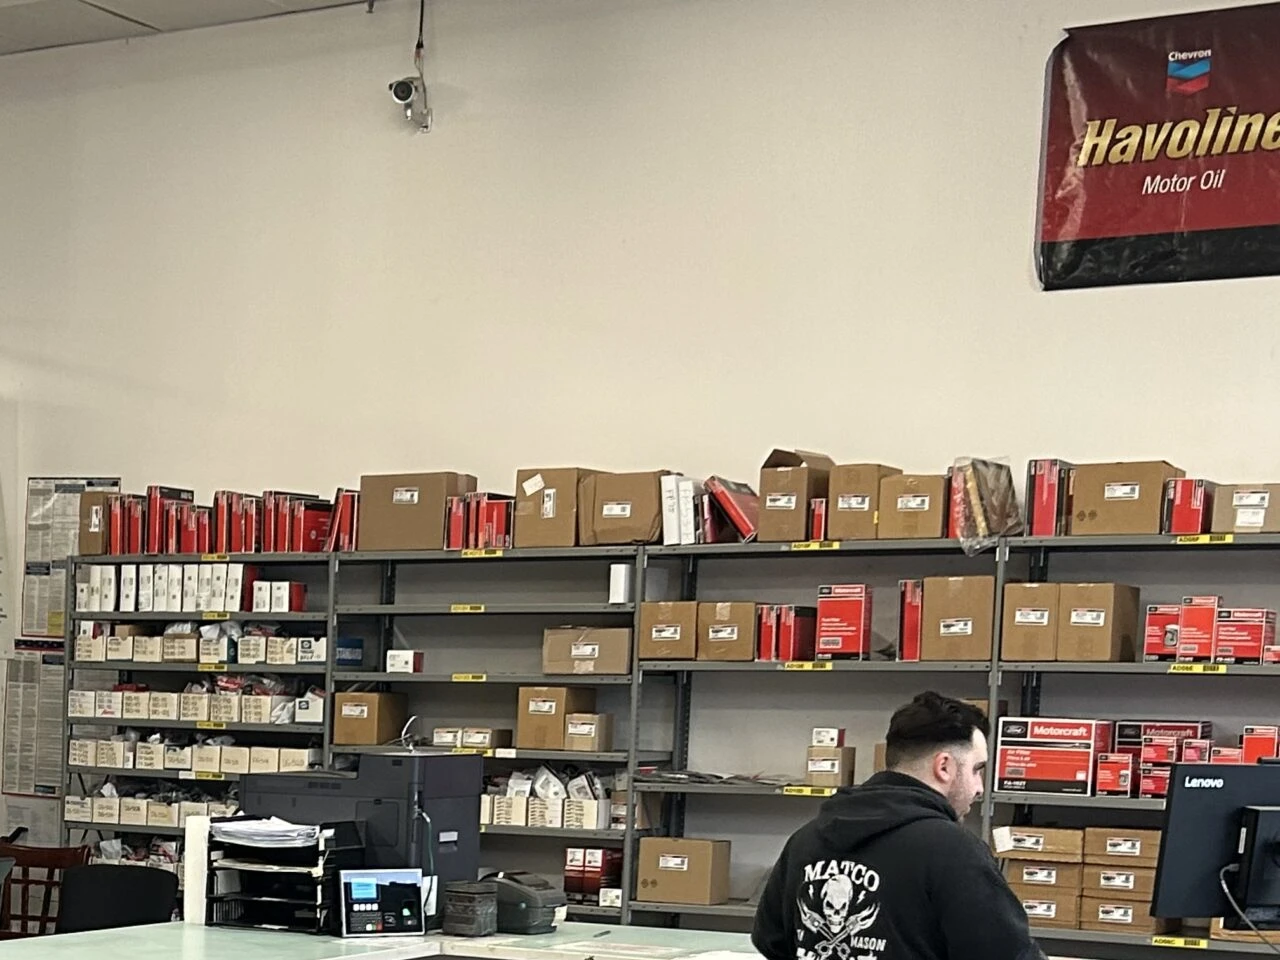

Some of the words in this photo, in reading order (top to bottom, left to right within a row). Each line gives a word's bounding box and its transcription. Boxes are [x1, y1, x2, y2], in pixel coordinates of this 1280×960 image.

[1168, 49, 1212, 62] Chevron
[1076, 106, 1280, 168] Havoline
[1142, 175, 1196, 195] Motor
[1200, 169, 1226, 190] Oil
[1033, 725, 1088, 737] Motorcraft
[1185, 776, 1223, 788] Lenovo
[804, 860, 880, 892] MATCO
[850, 936, 887, 952] MASON
